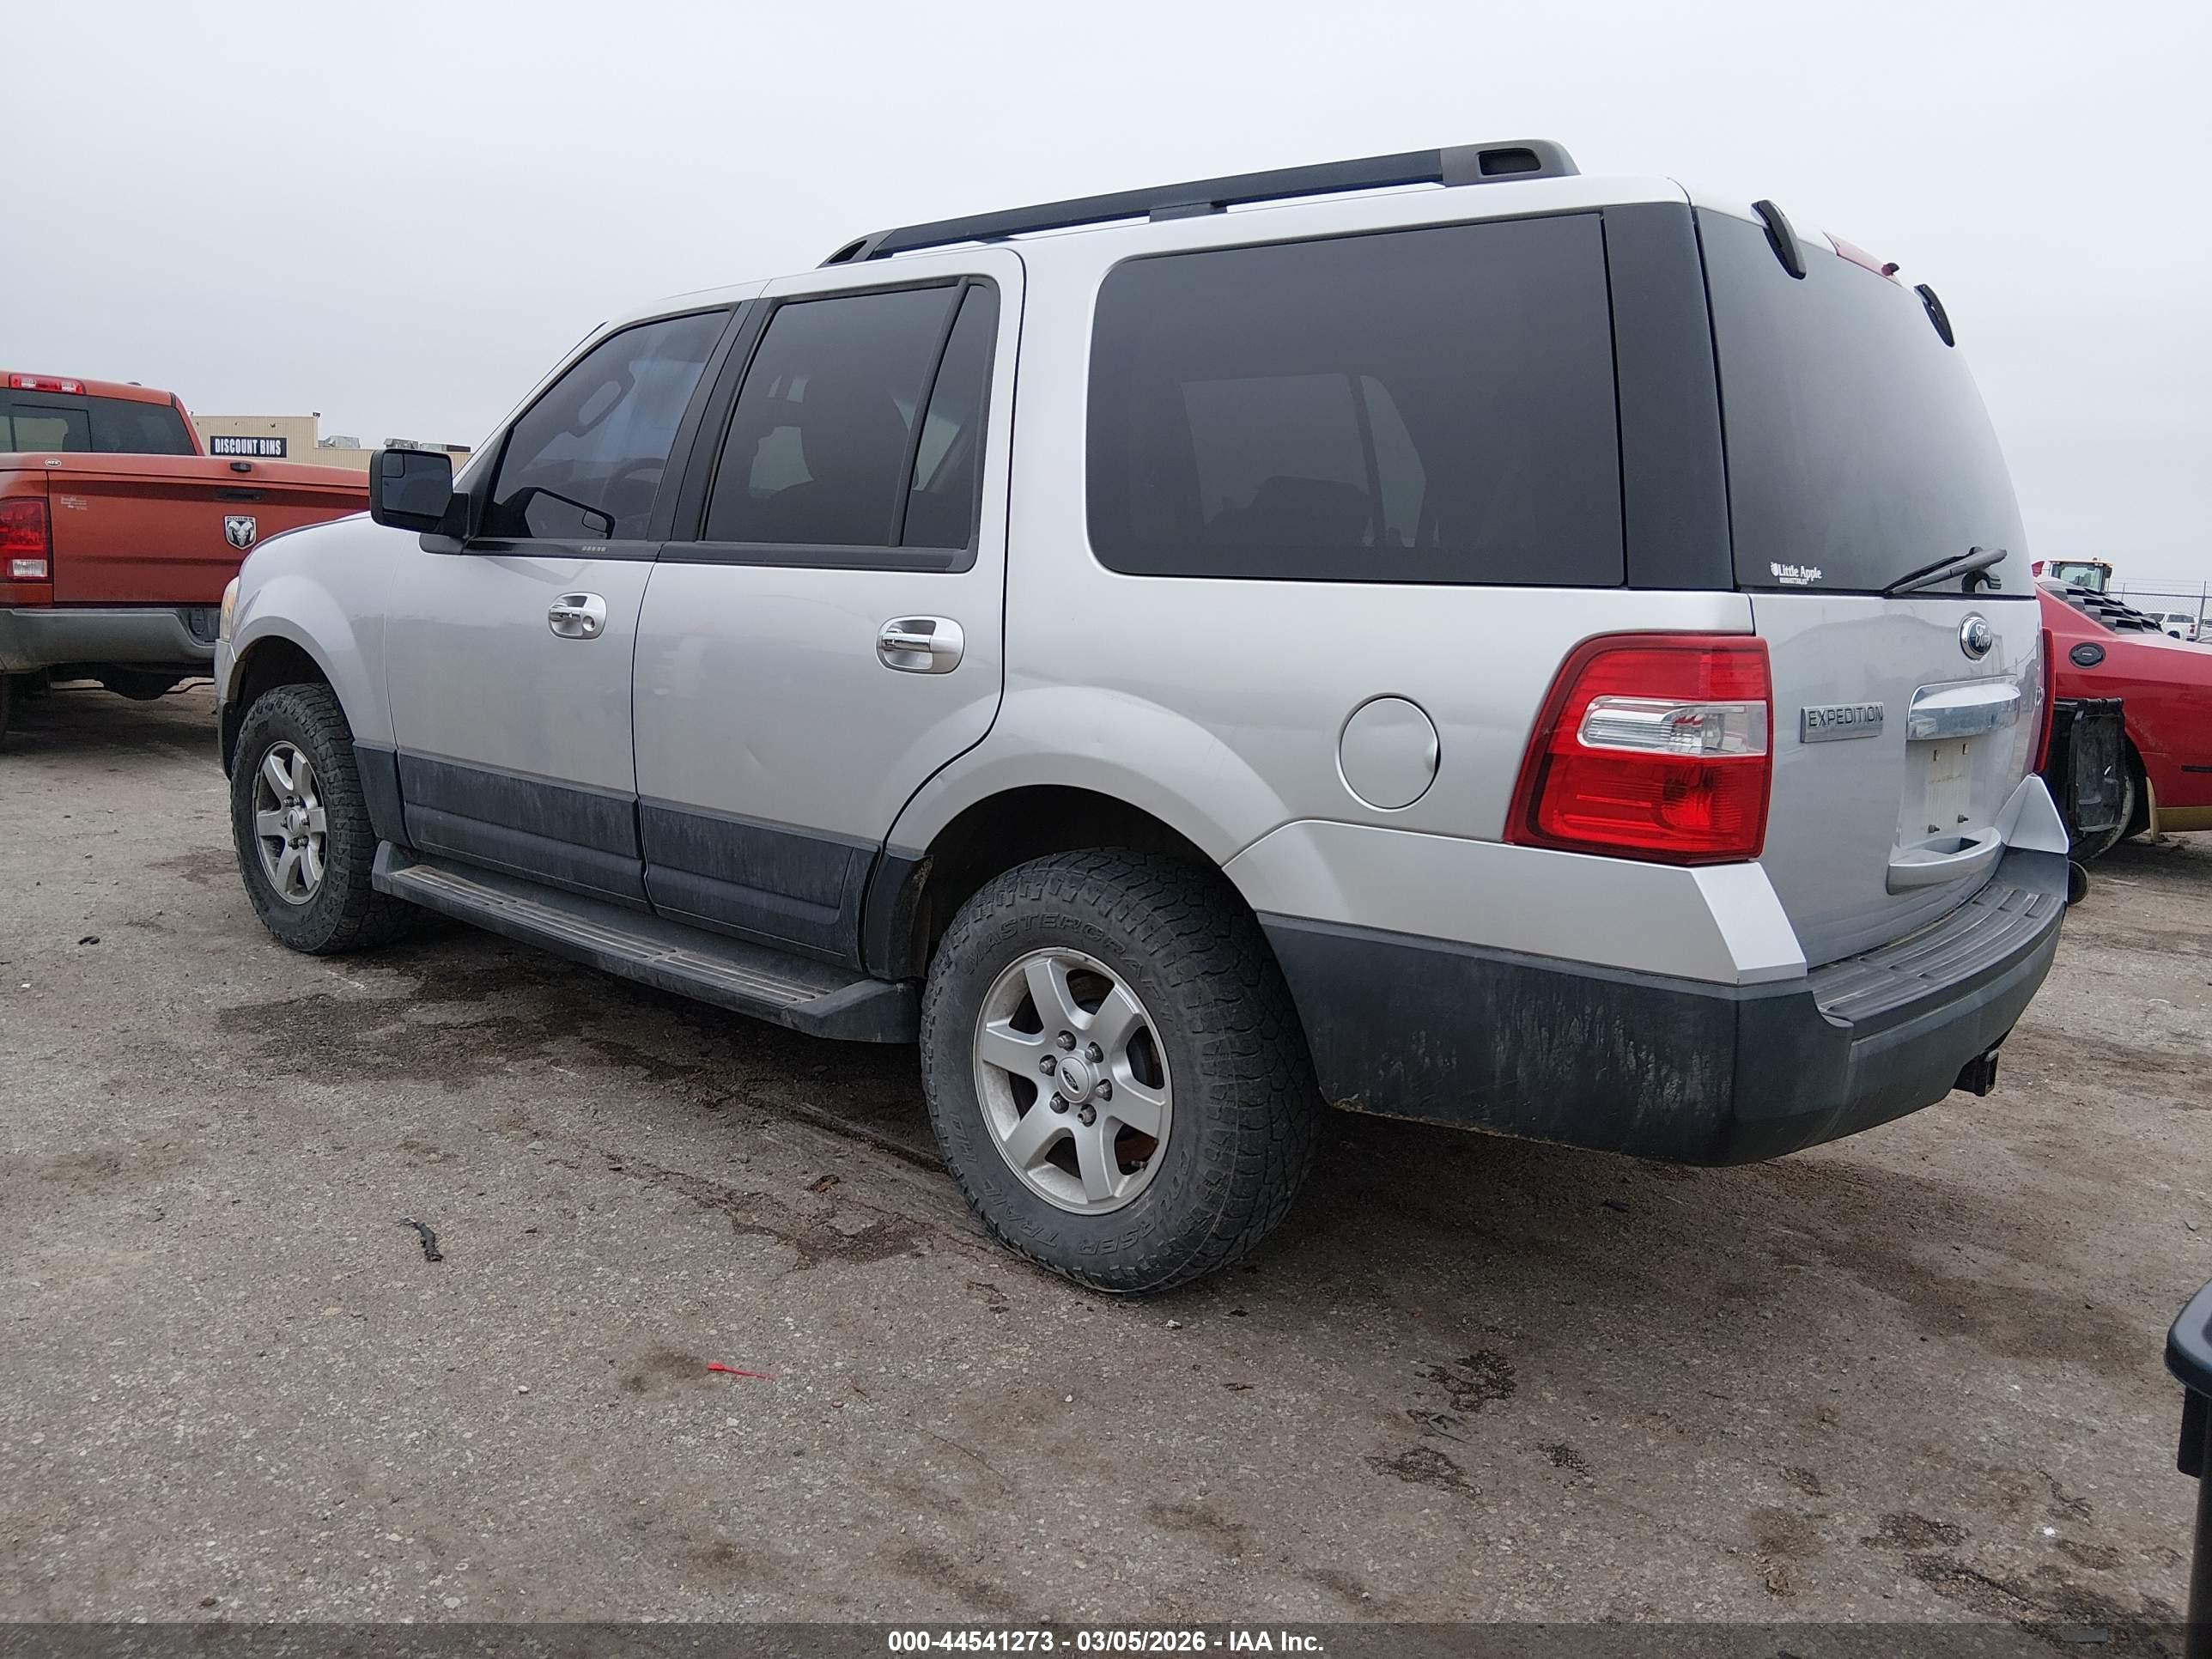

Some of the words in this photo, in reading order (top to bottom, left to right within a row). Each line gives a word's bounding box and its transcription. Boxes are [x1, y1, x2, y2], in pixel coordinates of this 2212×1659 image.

[215, 437, 258, 454] DISCOUNT
[259, 439, 282, 455] BINS
[1778, 564, 1799, 578] Little
[1800, 565, 1822, 582] Apple
[1808, 704, 1882, 727] EXPEDITION
